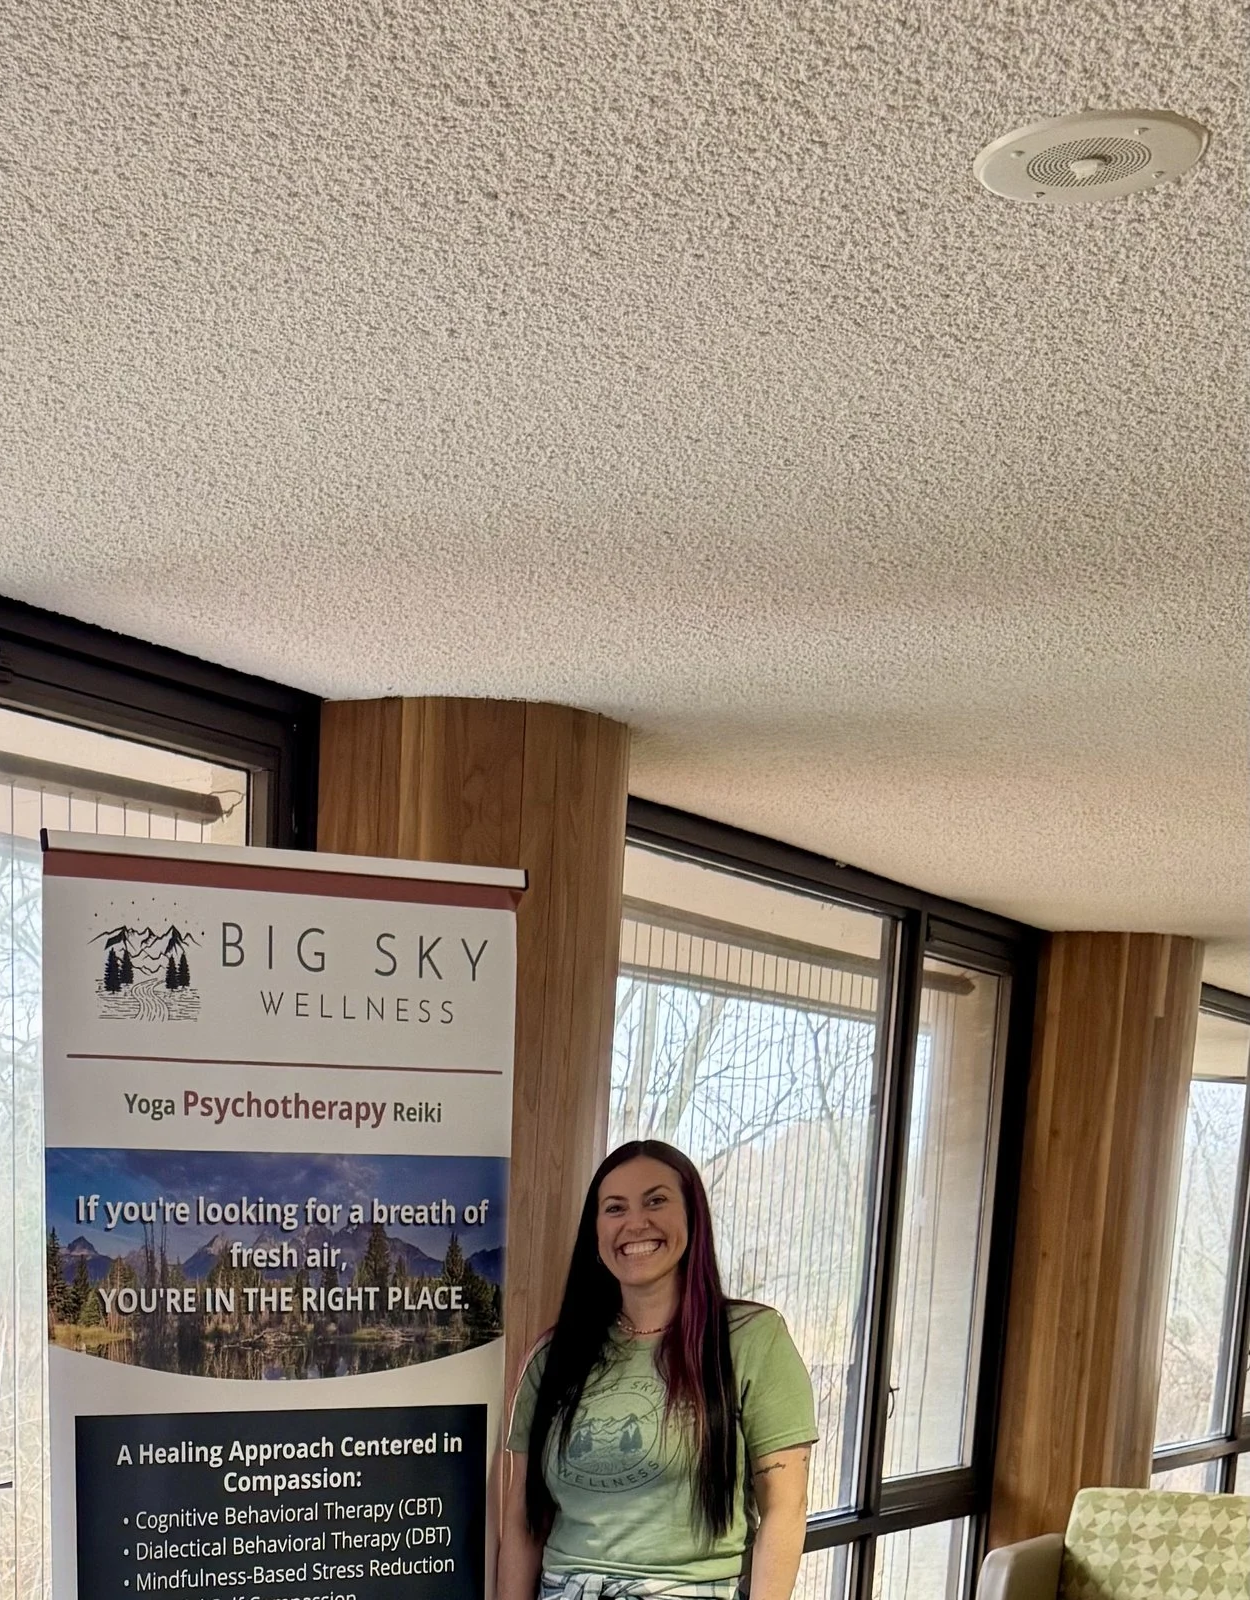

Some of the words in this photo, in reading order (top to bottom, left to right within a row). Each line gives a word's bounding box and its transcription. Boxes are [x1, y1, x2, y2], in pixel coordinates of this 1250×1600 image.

[222, 921, 327, 973] BIG
[375, 932, 488, 982] SKY
[260, 990, 454, 1024] WELLNESS
[124, 1092, 176, 1122] Yoga
[183, 1090, 386, 1128] Psychotherapy
[394, 1101, 442, 1123] Reiki
[76, 1195, 100, 1221] If
[107, 1196, 189, 1228] you're
[198, 1196, 298, 1229] looking
[305, 1197, 342, 1224] for
[349, 1204, 363, 1223] a
[373, 1199, 455, 1224] breath
[463, 1199, 488, 1224] of
[230, 1242, 298, 1268] fresh
[306, 1243, 347, 1272] air,
[99, 1287, 196, 1313] YOU'RE
[205, 1287, 234, 1312] IN
[247, 1287, 294, 1312] THE
[302, 1287, 378, 1312] RIGHT
[388, 1286, 469, 1311] PLACE.
[117, 1445, 132, 1466] A
[139, 1441, 222, 1468] Healing
[229, 1437, 334, 1466] Approach
[341, 1434, 436, 1457] Centered
[444, 1432, 462, 1453] in
[224, 1468, 361, 1496] Compassion:
[558, 1460, 660, 1489] WELLNESS
[136, 1509, 218, 1532] Cognitive
[225, 1503, 318, 1526] Behavioral
[324, 1500, 394, 1523] Therapy
[399, 1497, 442, 1519] (CBT)
[136, 1537, 226, 1561] Dialectical
[234, 1532, 325, 1555] Behavioral
[331, 1528, 400, 1552] Therapy
[406, 1526, 451, 1549] (DBT)
[136, 1564, 306, 1592] Mindfulness-Based
[312, 1562, 364, 1581] Stress
[370, 1556, 454, 1577] Reduction
